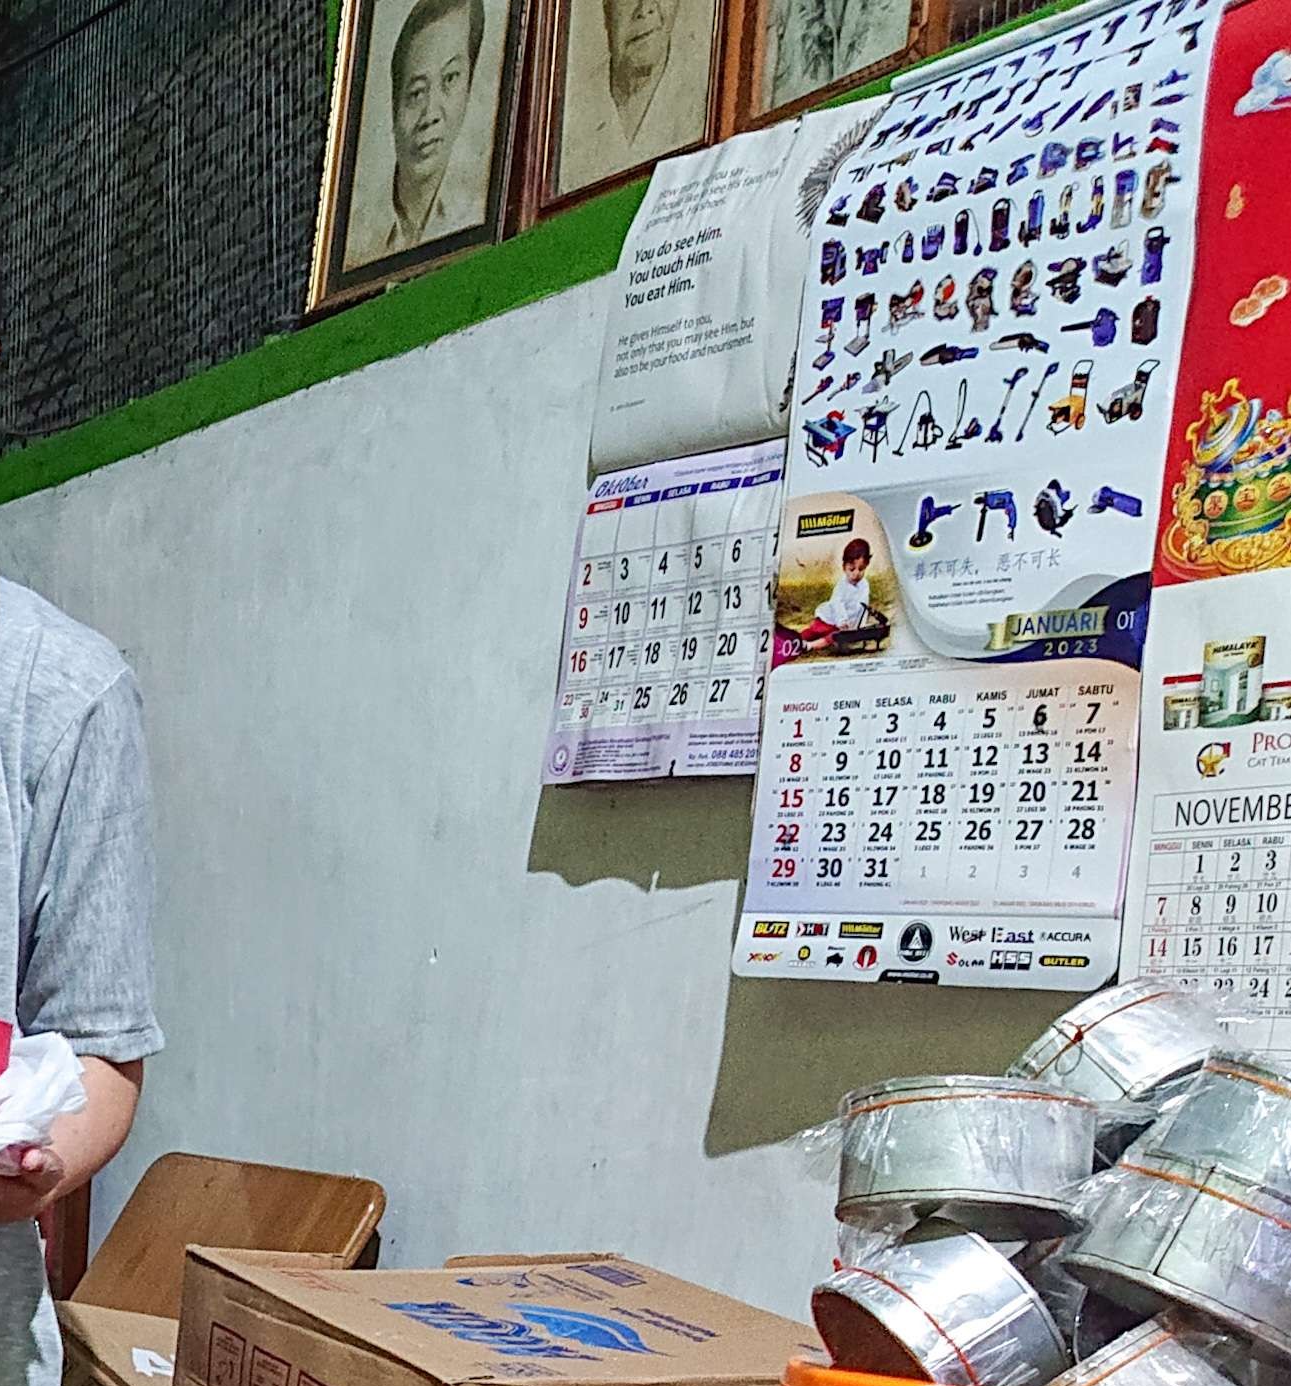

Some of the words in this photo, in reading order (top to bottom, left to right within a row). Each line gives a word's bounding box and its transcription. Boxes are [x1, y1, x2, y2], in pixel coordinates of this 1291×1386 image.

[635, 249, 655, 264] You
[657, 241, 671, 257] do
[674, 234, 694, 252] see
[696, 226, 722, 246] Him.
[629, 269, 650, 286] You
[651, 256, 684, 280] touch
[686, 250, 713, 270] Him.
[625, 290, 645, 309] You
[647, 286, 665, 302] eat
[668, 277, 695, 297] Him.
[583, 563, 592, 586] 2
[620, 557, 629, 580] 3
[658, 551, 668, 574] 4
[694, 545, 703, 569] 5
[732, 539, 742, 563] 6
[578, 607, 588, 629] 9
[614, 601, 630, 624] 10
[651, 597, 667, 620] 11
[688, 591, 702, 615] 12
[724, 585, 742, 610] 13
[1013, 614, 1098, 636] JANUARI
[571, 650, 587, 673] 16
[608, 646, 625, 669] 17
[645, 642, 661, 664] 18
[682, 637, 697, 661] 19
[717, 632, 737, 657] 20
[1044, 638, 1099, 656] 2023
[1213, 641, 1259, 654] HIMALAYA
[634, 686, 652, 710] 25
[669, 682, 689, 706] 26
[709, 679, 730, 703] 27
[783, 702, 819, 712] MINGGU
[833, 700, 861, 710] SENIN
[875, 697, 913, 708] SELASA
[929, 694, 957, 705] RABU
[976, 690, 1007, 702] KAMIS
[1026, 687, 1060, 699] JUMAT
[1078, 684, 1114, 696] SABTU
[793, 719, 803, 738] 1
[838, 716, 850, 736] 2
[886, 713, 899, 733] 3
[934, 711, 946, 731] 4
[983, 708, 996, 729] 5
[1033, 704, 1048, 727] 6
[1086, 702, 1101, 724] 7
[789, 753, 802, 773] 8
[836, 751, 848, 772] 9
[876, 749, 901, 770] 10
[924, 748, 948, 768] 11
[972, 746, 998, 767] 12
[1022, 743, 1049, 764] 13
[1074, 741, 1102, 763] 14
[780, 789, 804, 808] 15
[826, 787, 850, 807] 16
[872, 786, 898, 806] 17
[920, 784, 946, 805] 18
[969, 782, 995, 803] 19
[1019, 781, 1046, 802] 20
[1071, 780, 1098, 801] 21
[776, 824, 800, 844] 22
[821, 822, 847, 842] 23
[868, 822, 893, 842] 24
[916, 821, 942, 841] 25
[965, 820, 992, 841] 26
[1016, 820, 1043, 841] 27
[1067, 818, 1096, 840] 28
[1192, 840, 1213, 849] SENIN
[1223, 838, 1251, 847] SELASA
[1262, 836, 1284, 845] RABU
[772, 858, 796, 878] 29
[817, 858, 843, 878] 30
[864, 858, 888, 878] 31
[968, 865, 977, 878] 2
[1020, 865, 1028, 878] 3
[1072, 865, 1081, 878] 4
[1196, 854, 1203, 873] 1
[1230, 852, 1240, 872] 2
[1266, 850, 1277, 870] 3
[1157, 897, 1167, 915] 7
[1190, 895, 1201, 915] 8
[1226, 894, 1236, 914] 9
[1256, 892, 1277, 913] 10
[755, 922, 786, 934] BLITZ
[949, 926, 986, 942] West
[1046, 931, 1092, 942] ACCURA
[1148, 938, 1167, 957] 14
[1182, 937, 1202, 957] 15
[1218, 936, 1237, 956] 16
[1253, 936, 1274, 955] 17
[1044, 957, 1086, 966] BUTLER
[1250, 978, 1269, 998] 24
